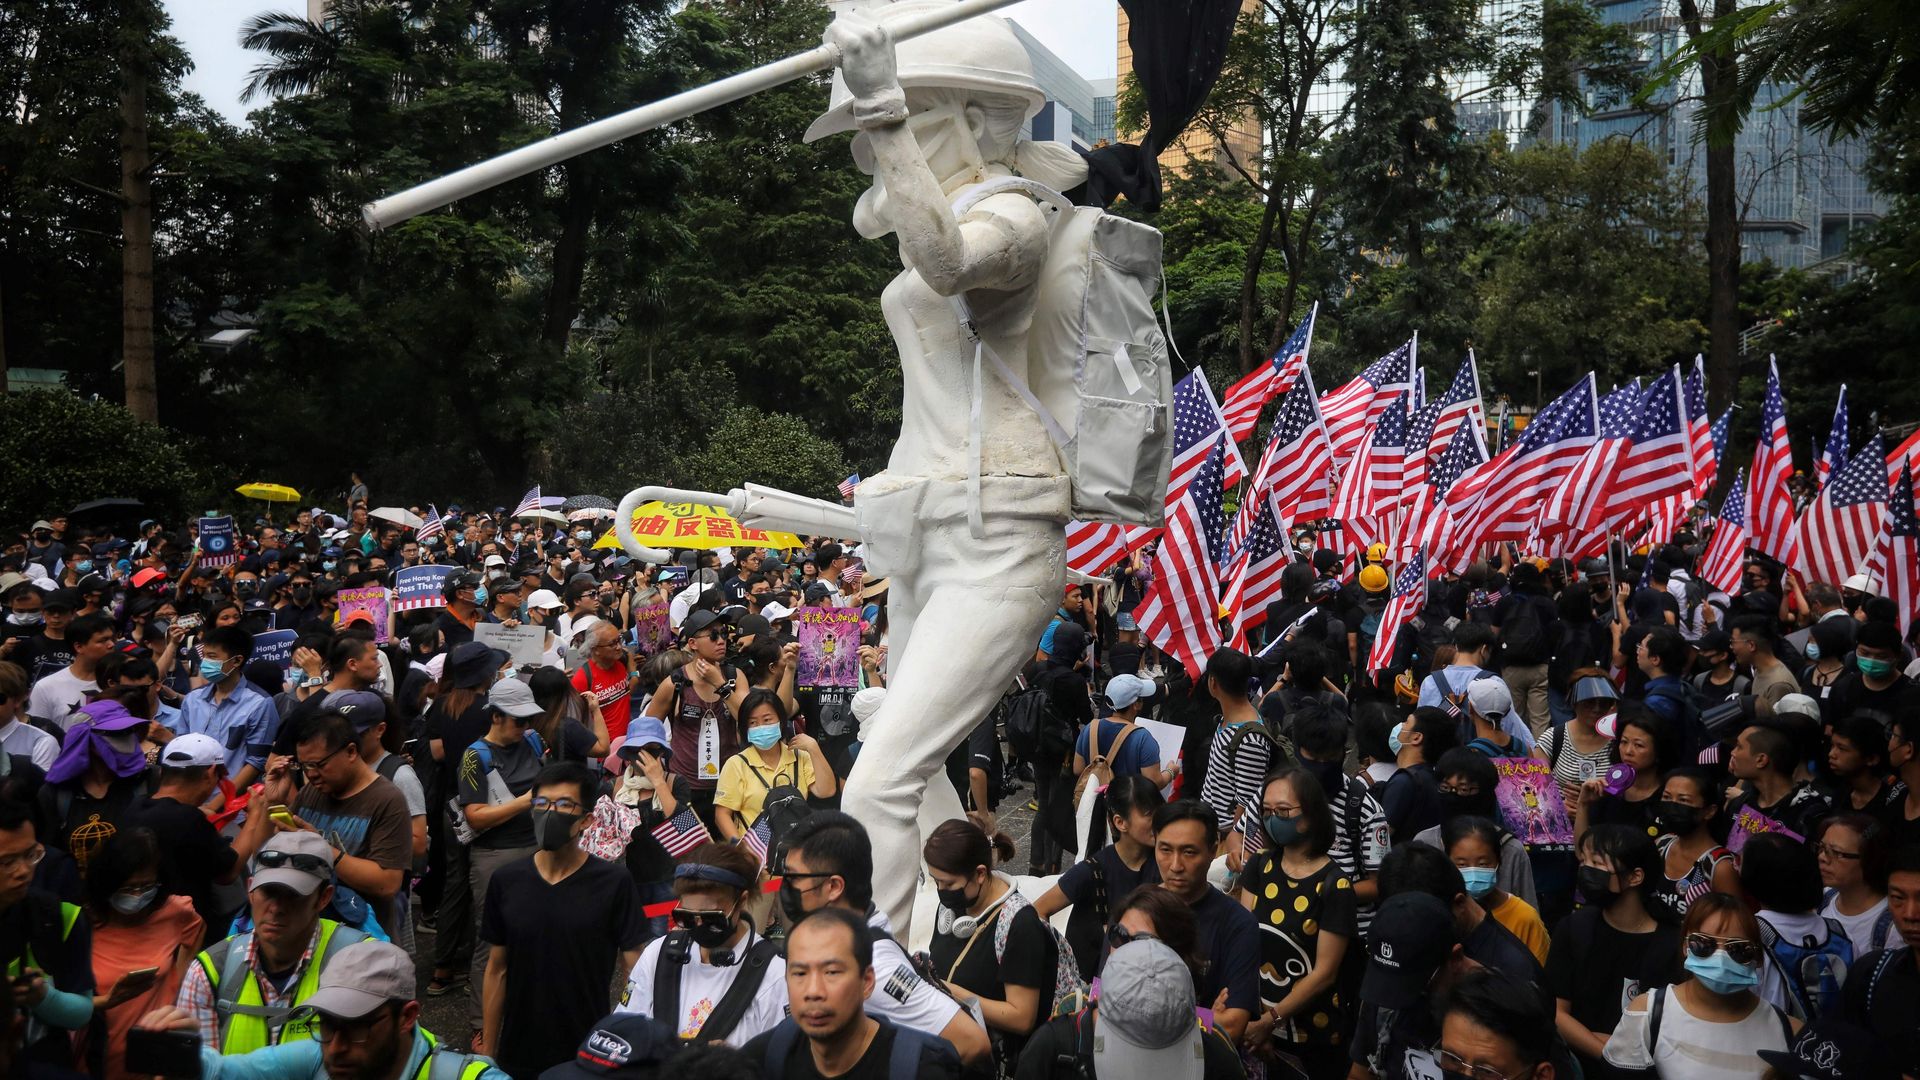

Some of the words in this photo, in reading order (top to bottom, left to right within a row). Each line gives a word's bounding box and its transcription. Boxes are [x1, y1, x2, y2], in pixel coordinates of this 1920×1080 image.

[608, 515, 769, 542] 油反惡法
[412, 575, 431, 583] Hong
[399, 585, 415, 593] Pass
[416, 582, 434, 590] The
[803, 612, 859, 624] 香港人加油
[256, 644, 277, 653] Hong
[262, 652, 281, 661] The
[596, 685, 616, 698] OSAKA
